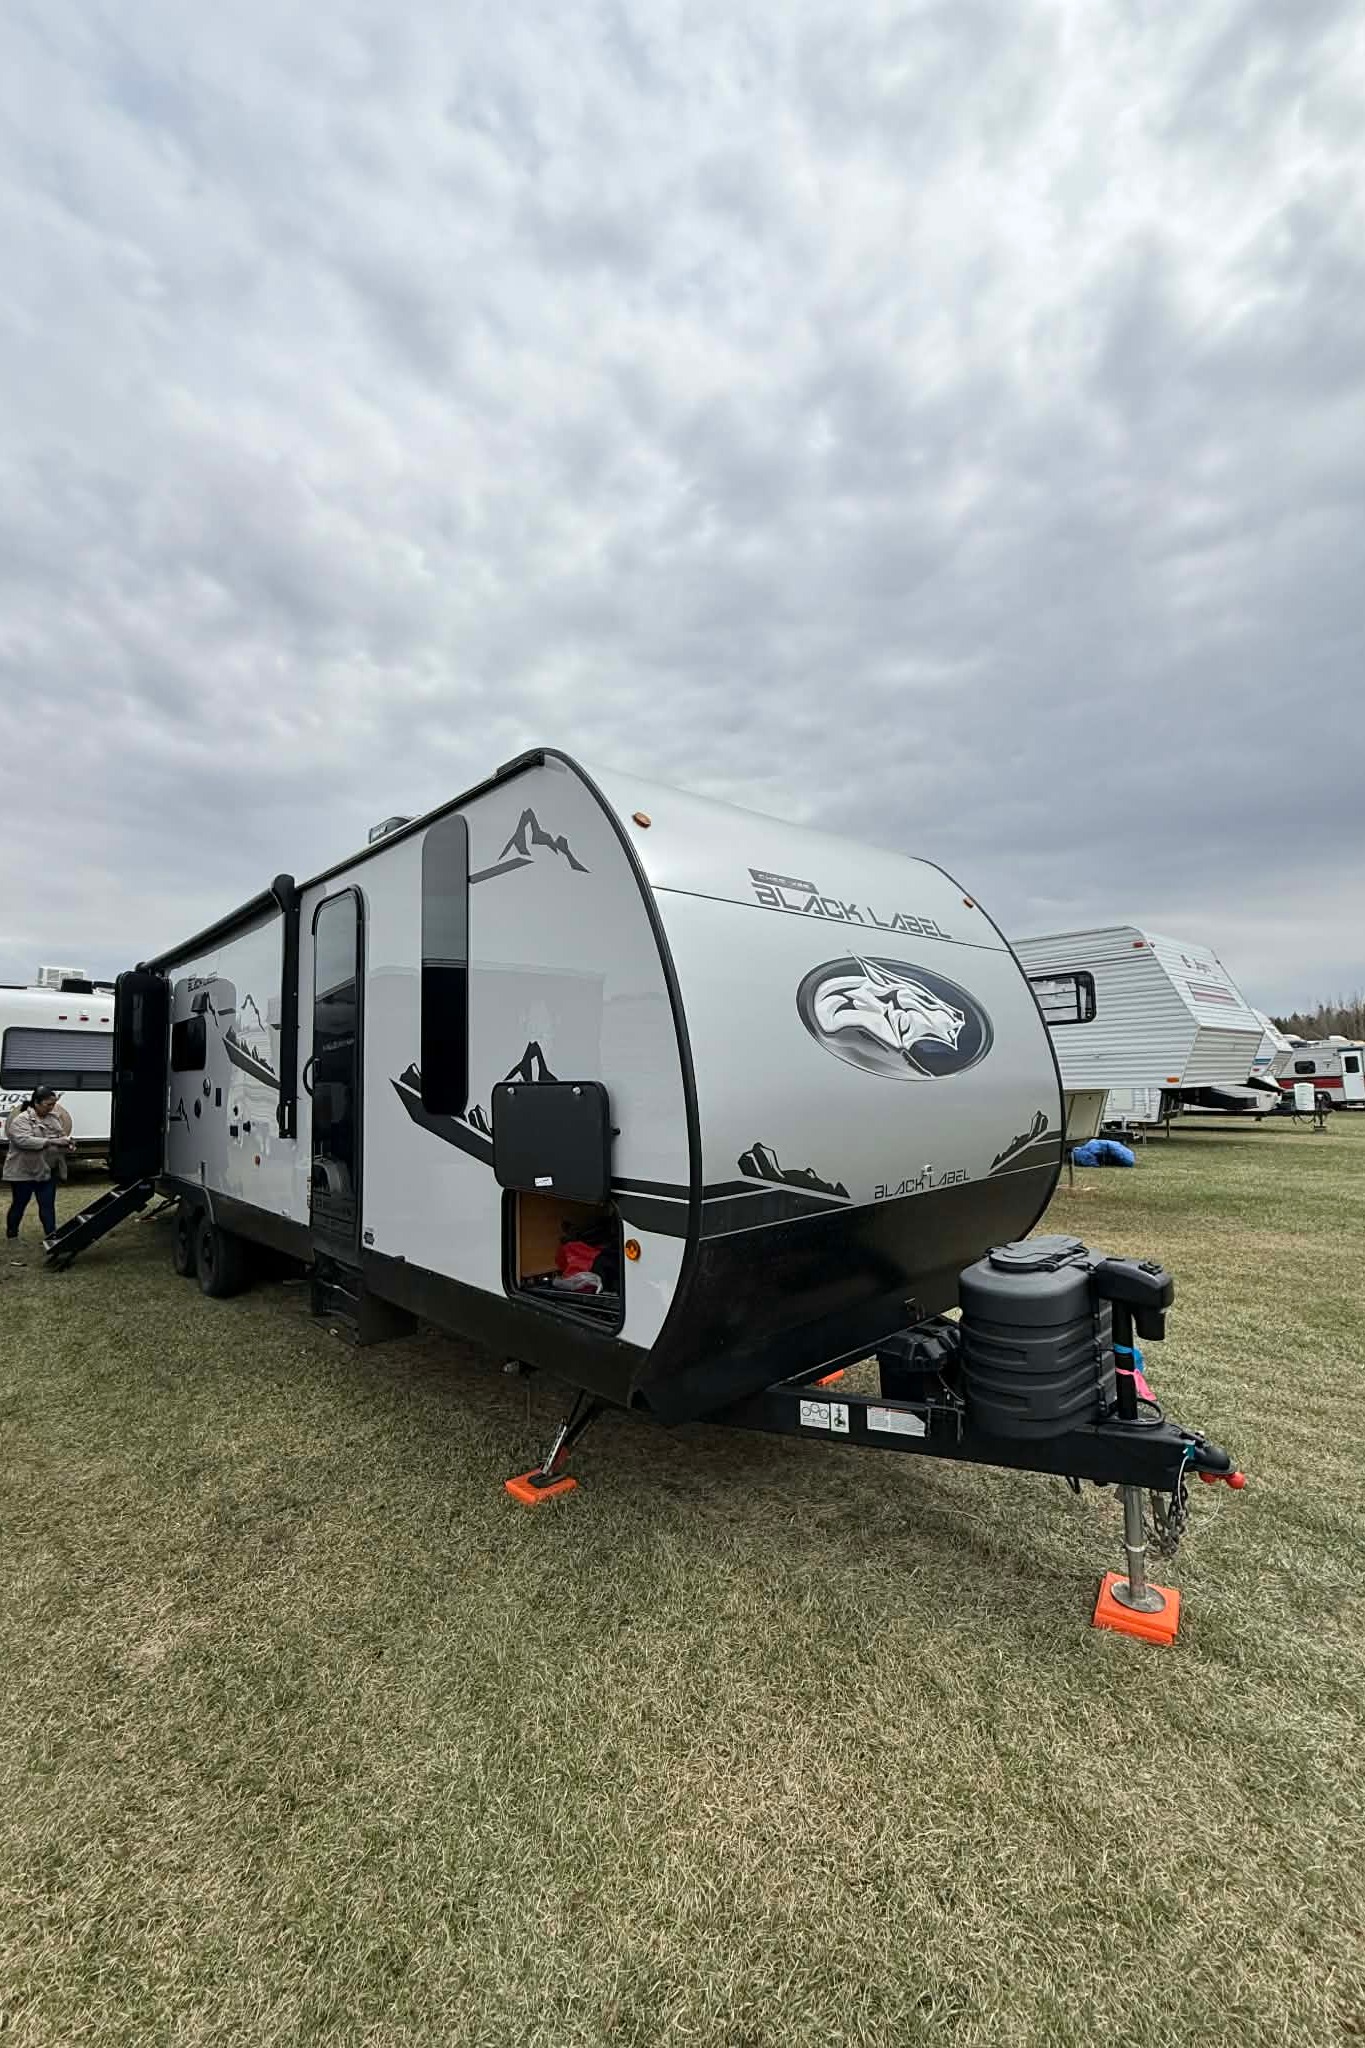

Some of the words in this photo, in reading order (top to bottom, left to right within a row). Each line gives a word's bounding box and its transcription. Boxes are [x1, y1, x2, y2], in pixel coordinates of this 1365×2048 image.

[751, 881, 865, 924] BLACK
[867, 906, 953, 939] LABEL
[874, 1174, 927, 1200] BLACK
[929, 1169, 971, 1189] LABEL
